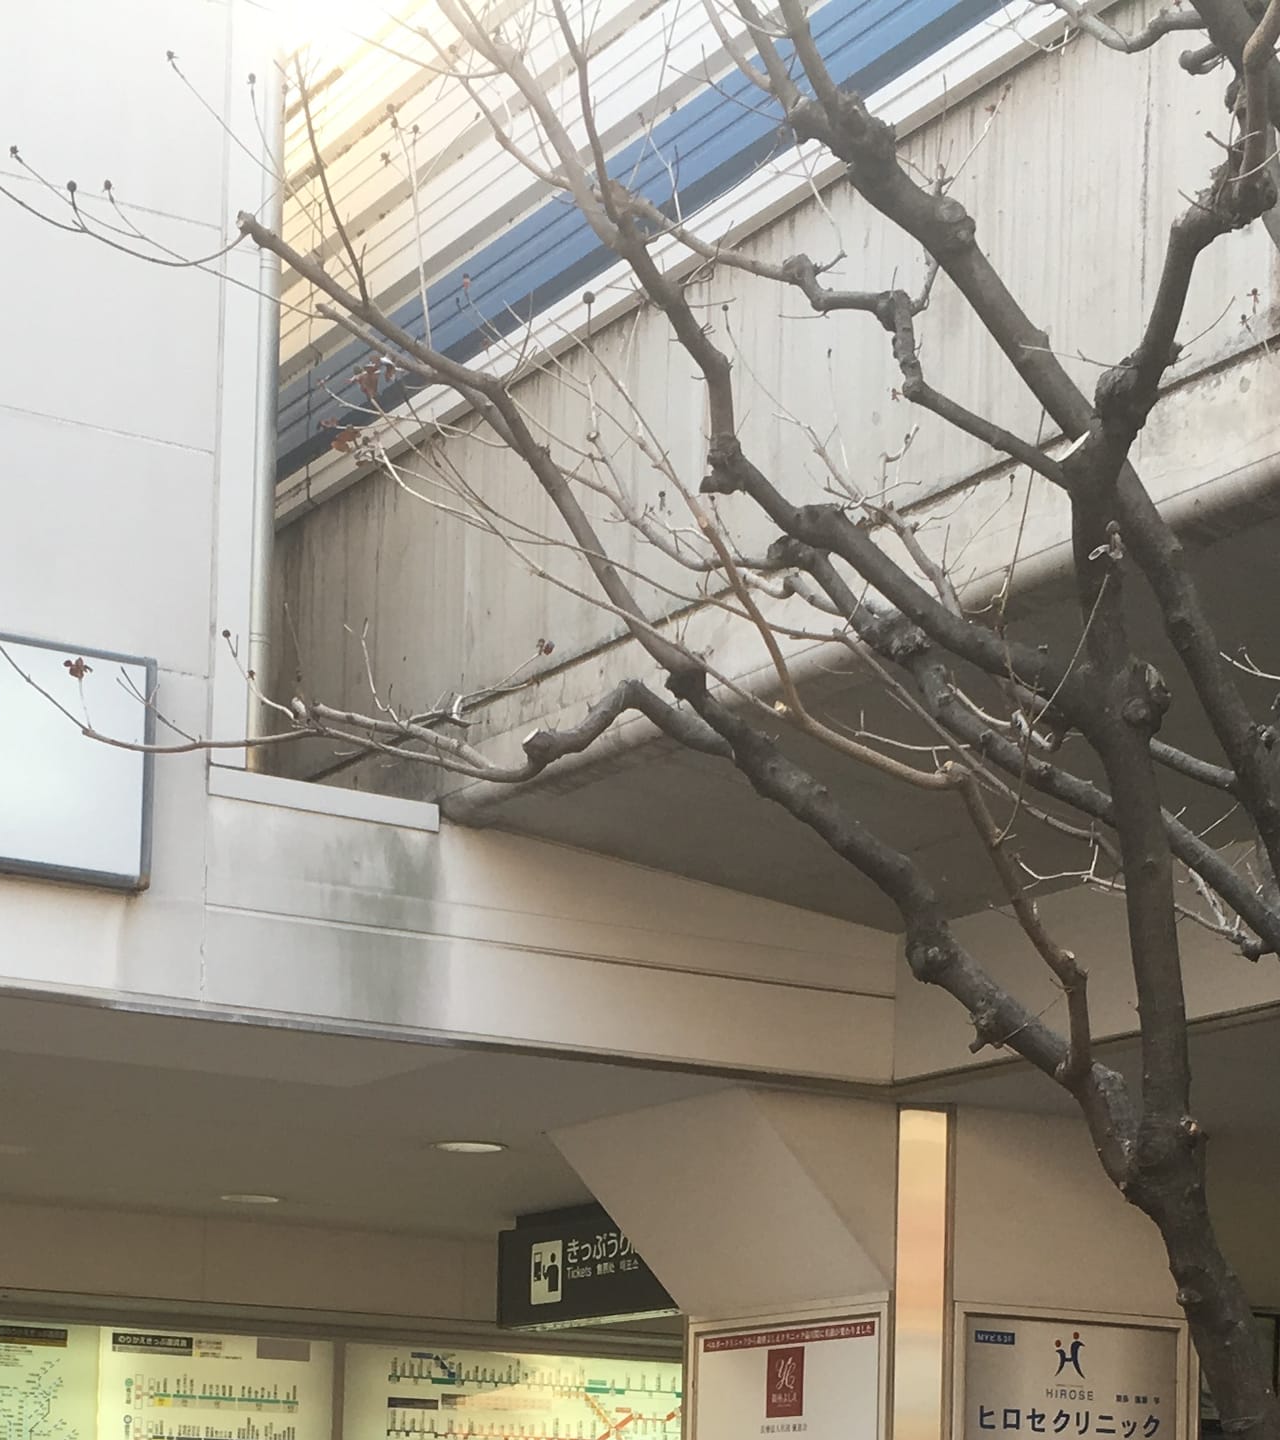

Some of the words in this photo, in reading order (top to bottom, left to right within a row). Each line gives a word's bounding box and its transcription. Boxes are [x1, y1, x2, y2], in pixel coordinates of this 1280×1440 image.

[566, 1231, 640, 1264] きっぷうり
[1046, 1388, 1095, 1401] HIROSE
[979, 1405, 1161, 1439] ヒロセクリニック
